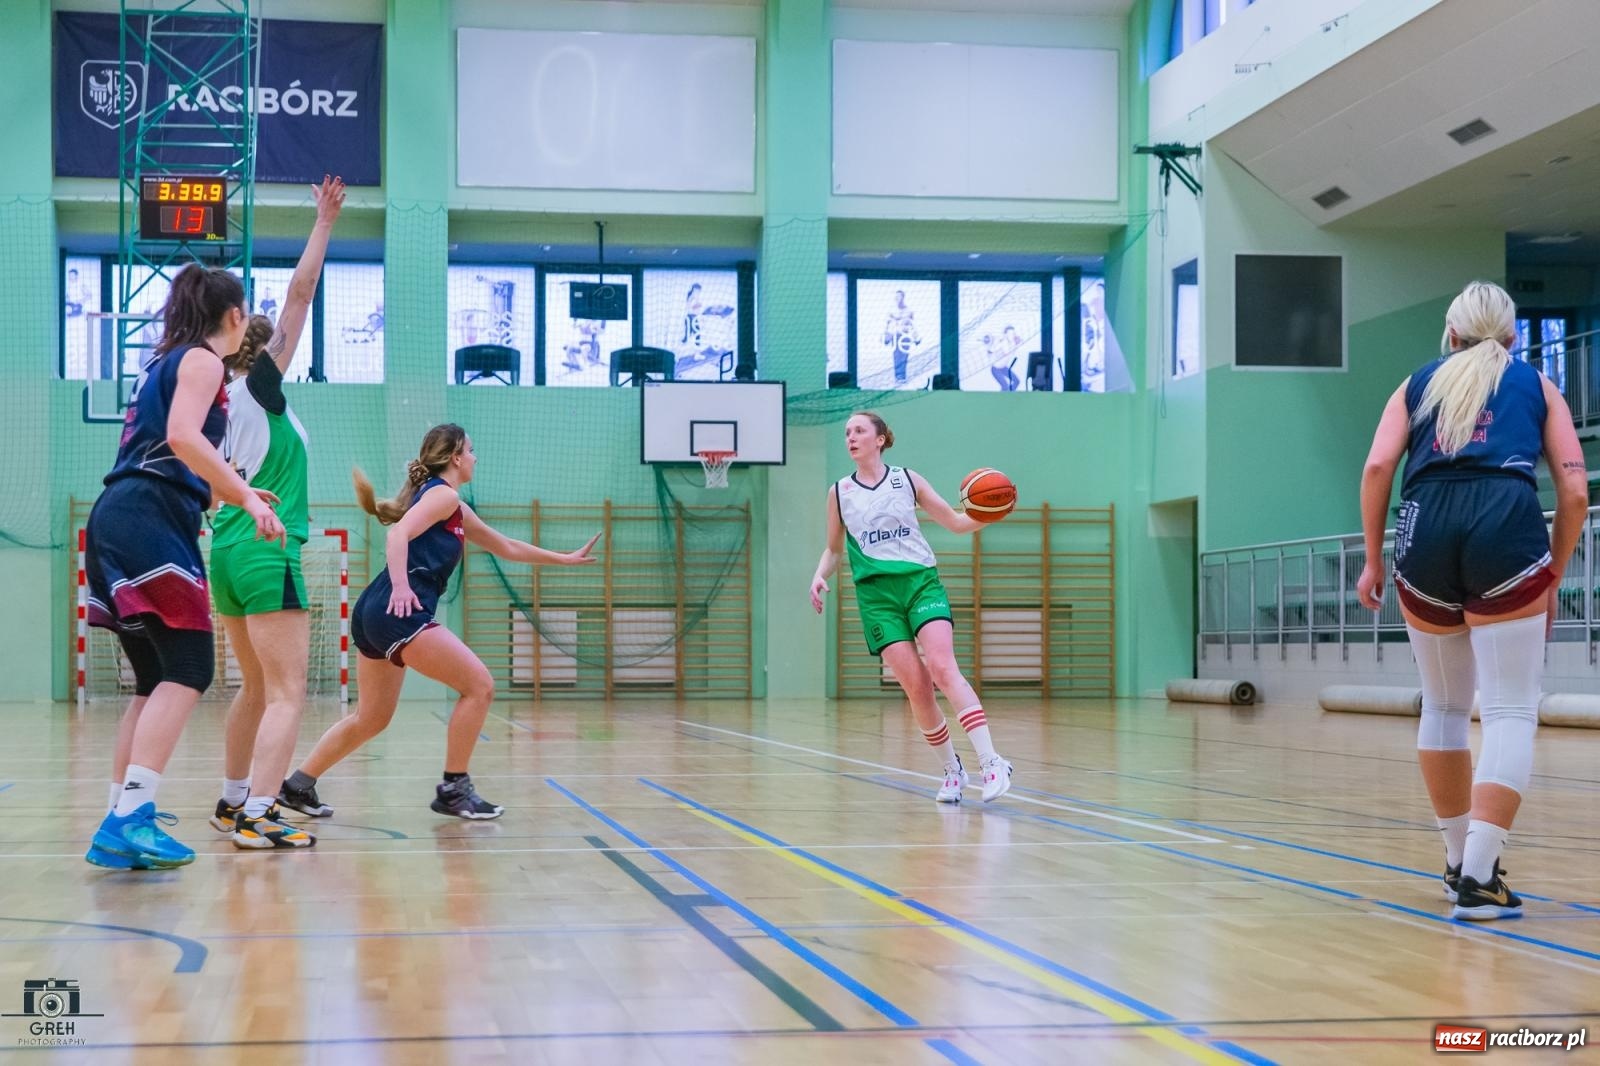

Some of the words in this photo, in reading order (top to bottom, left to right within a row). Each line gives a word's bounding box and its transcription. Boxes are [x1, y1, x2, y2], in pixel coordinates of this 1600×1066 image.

[167, 79, 358, 117] RACIBÓRZ
[172, 206, 207, 234] 13
[868, 525, 911, 544] Clavis
